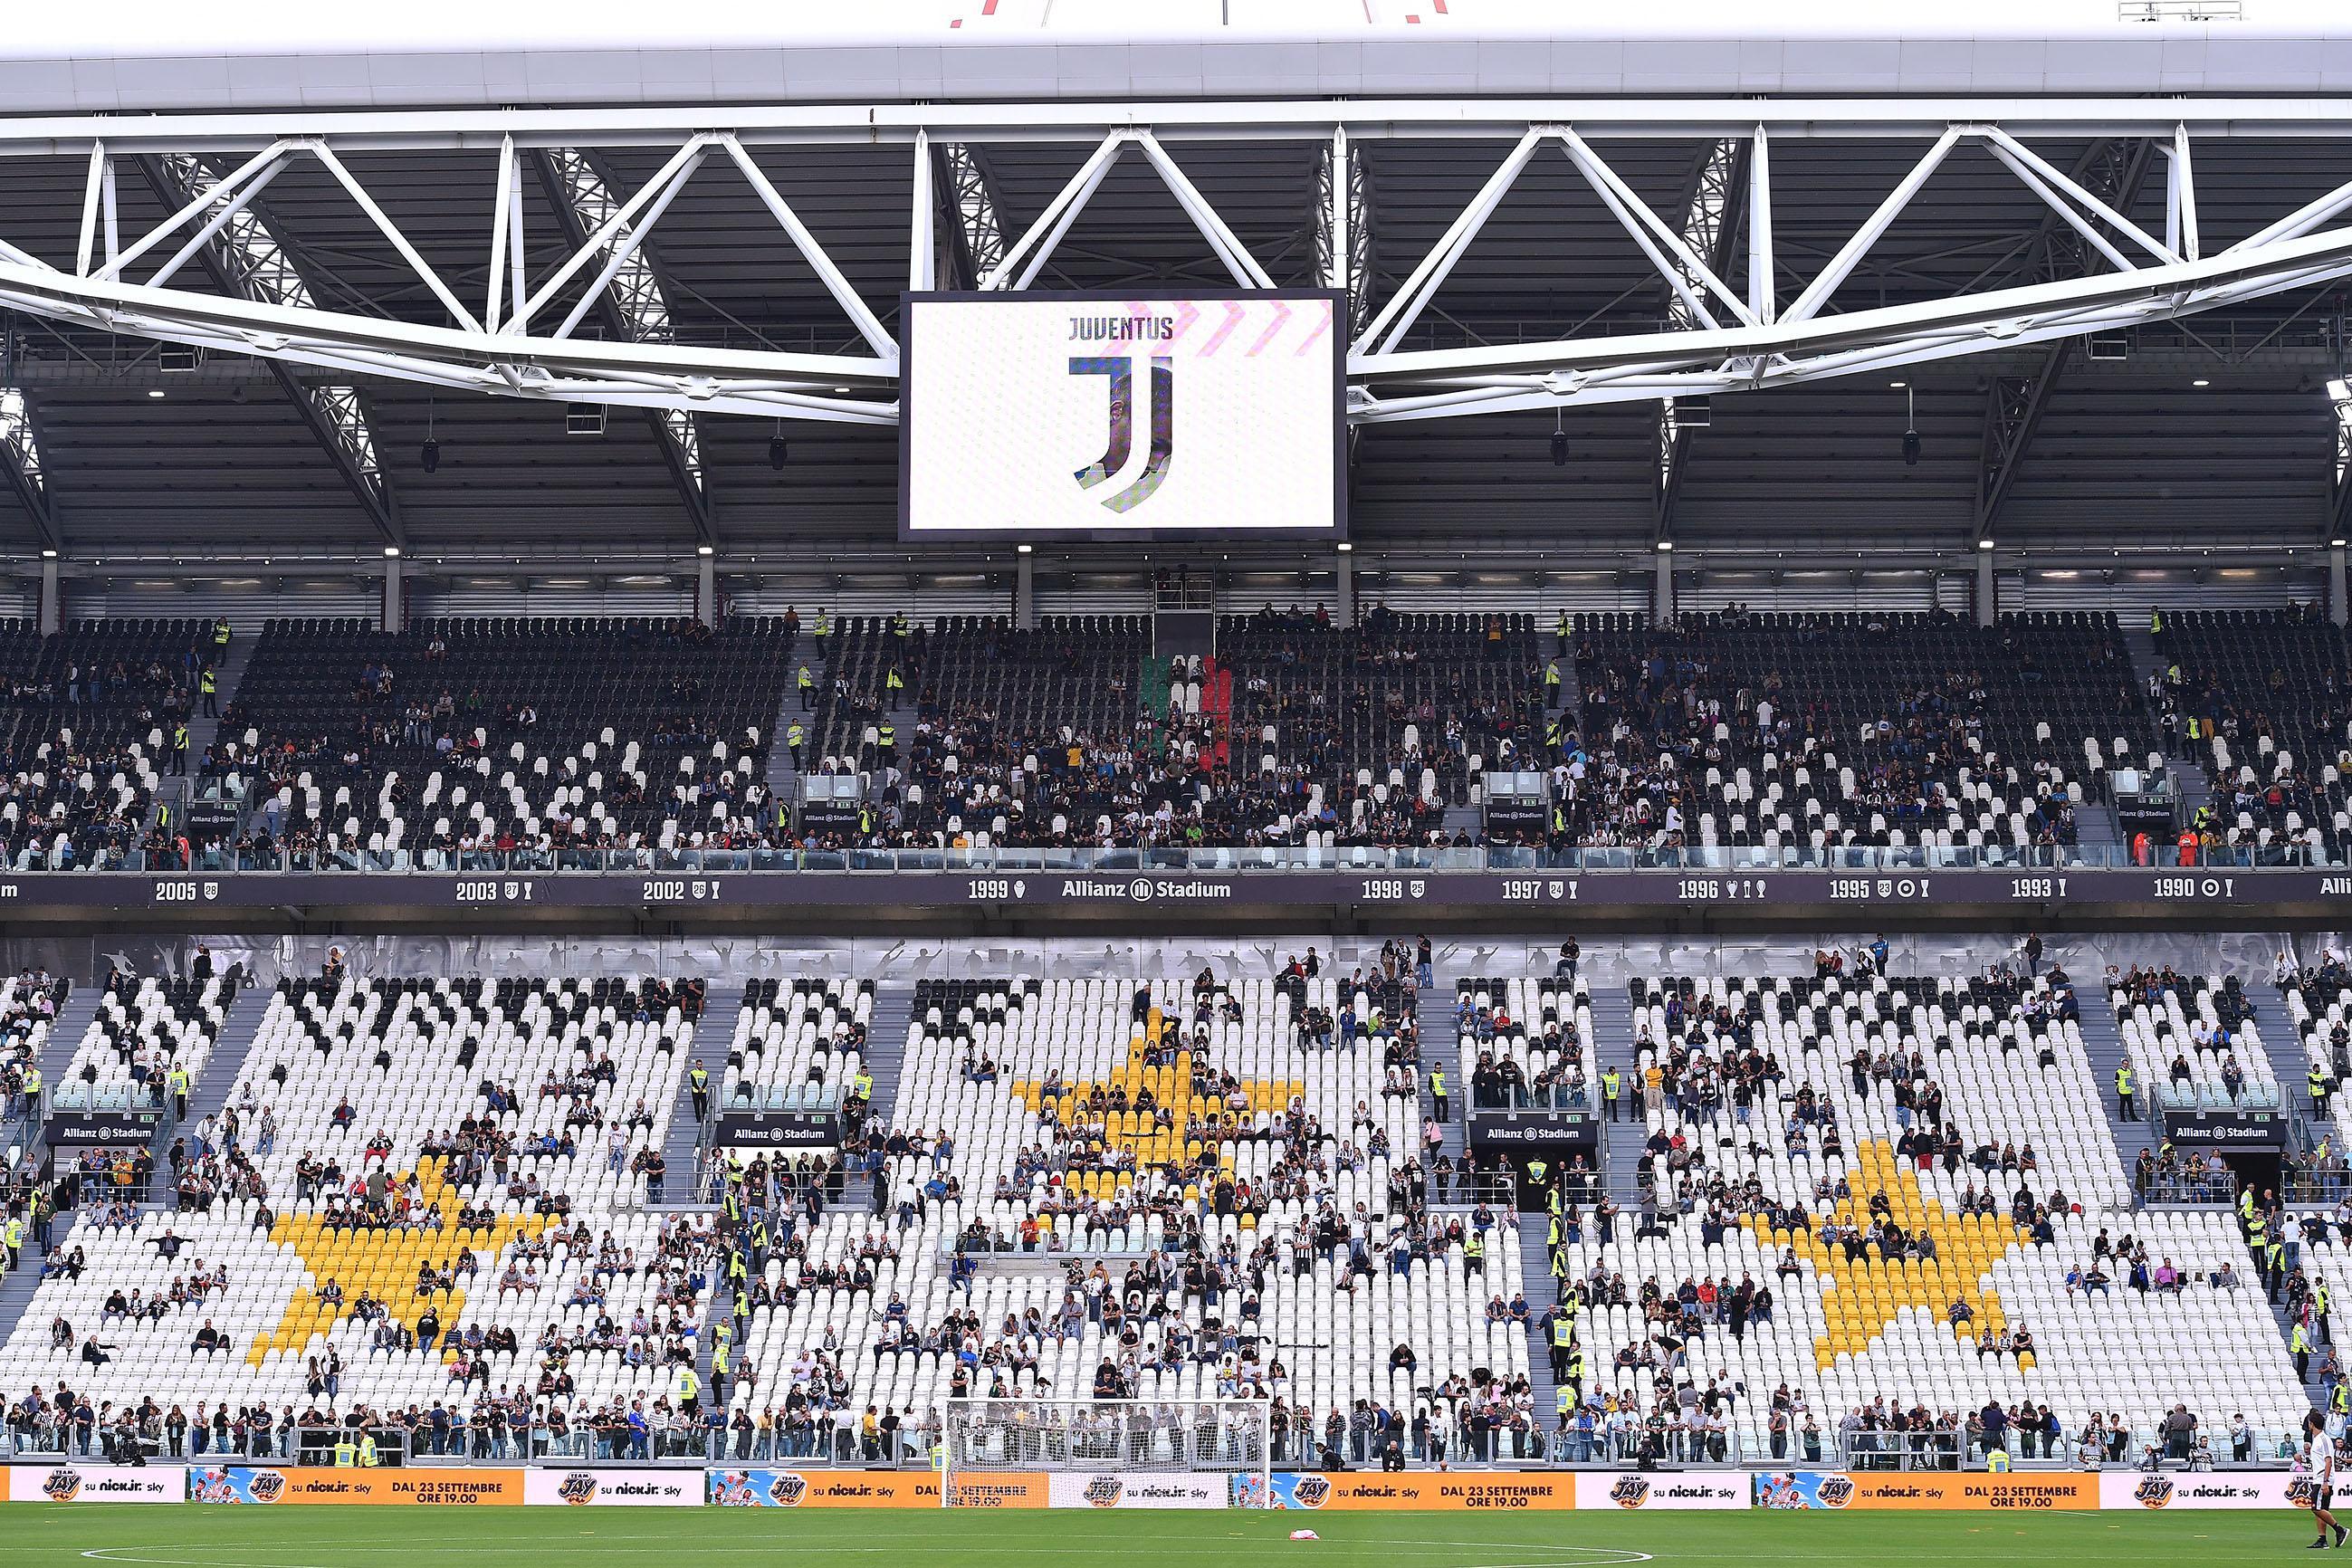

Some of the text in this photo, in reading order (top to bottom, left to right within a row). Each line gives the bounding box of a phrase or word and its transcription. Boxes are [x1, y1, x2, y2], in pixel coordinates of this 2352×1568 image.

[1068, 317, 1173, 340] JUVENTUS
[157, 883, 216, 900] 2005 28
[456, 883, 517, 900] 2003 27
[644, 882, 705, 900] 2002 26
[969, 881, 1009, 899] 1999
[1062, 881, 1230, 897] Allianz Stadium
[1362, 881, 1423, 899] 1998 25
[1503, 881, 1562, 899] 1997 24
[1678, 881, 1718, 899] 1996
[1830, 880, 1889, 898] 1995 23
[2012, 879, 2051, 896] 1993
[2155, 879, 2194, 896] 1990
[62, 1128, 152, 1138] Allianz Stadium
[734, 1129, 825, 1139] Allianz Stadium
[1487, 1128, 1579, 1139] Allianz Stadium
[2175, 1127, 2268, 1138] Allianz Stadium
[1411, 1172, 1421, 1183] 10
[43, 1476, 81, 1493] JAY
[85, 1483, 96, 1491] su
[148, 1483, 165, 1494] sky
[250, 1477, 284, 1493] JAY
[354, 1484, 372, 1495] sky
[393, 1482, 502, 1492] DAL 23 SETTEMBRE
[558, 1479, 597, 1496] JAY
[770, 1482, 806, 1497] JAY
[915, 1485, 938, 1496] DAL
[1295, 1482, 1330, 1498] JAY
[1441, 1486, 1554, 1496] DAL 23 SETTEMBRE
[1610, 1481, 1649, 1499] JAY
[1818, 1482, 1853, 1498] JAY
[1965, 1486, 2077, 1496] DAL 23 SETTEMBRE
[2134, 1482, 2175, 1499] JAY
[2284, 1481, 2315, 1499] JA
[417, 1493, 478, 1503] ORE 19.00
[600, 1487, 612, 1495] su
[664, 1486, 682, 1497] sky
[813, 1488, 825, 1496] su
[877, 1487, 894, 1498] sky
[1190, 1488, 1208, 1499] sky
[1337, 1489, 1349, 1497] su
[1402, 1488, 1420, 1499] sky
[1654, 1489, 1665, 1497] su
[1718, 1487, 1736, 1499] sky
[1861, 1489, 1872, 1497] su
[1926, 1487, 1944, 1499] sky
[2178, 1489, 2189, 1497] su
[2242, 1487, 2261, 1499] sky
[1467, 1496, 1528, 1507] ORE 19.00
[1990, 1496, 2052, 1507] ORE 19.00
